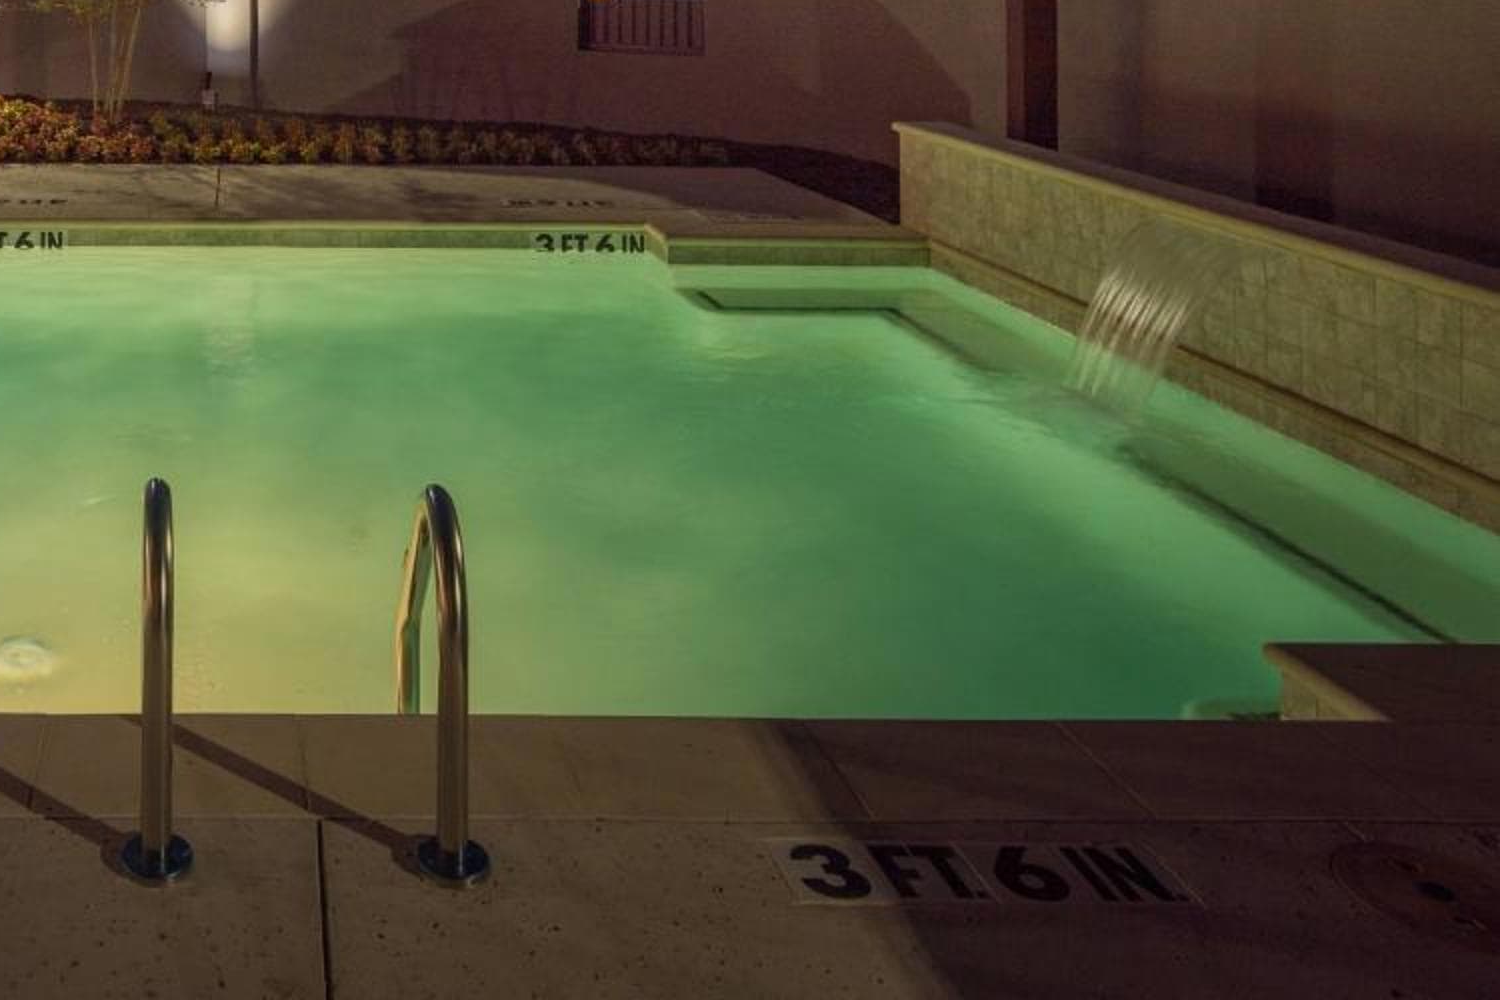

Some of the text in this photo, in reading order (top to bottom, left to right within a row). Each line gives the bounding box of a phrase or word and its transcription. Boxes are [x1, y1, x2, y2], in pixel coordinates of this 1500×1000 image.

[40, 231, 63, 248] IN
[535, 233, 555, 252] 3
[561, 234, 589, 252] FT
[621, 234, 645, 253] IN
[789, 843, 871, 899] 3
[995, 846, 1070, 901] 6
